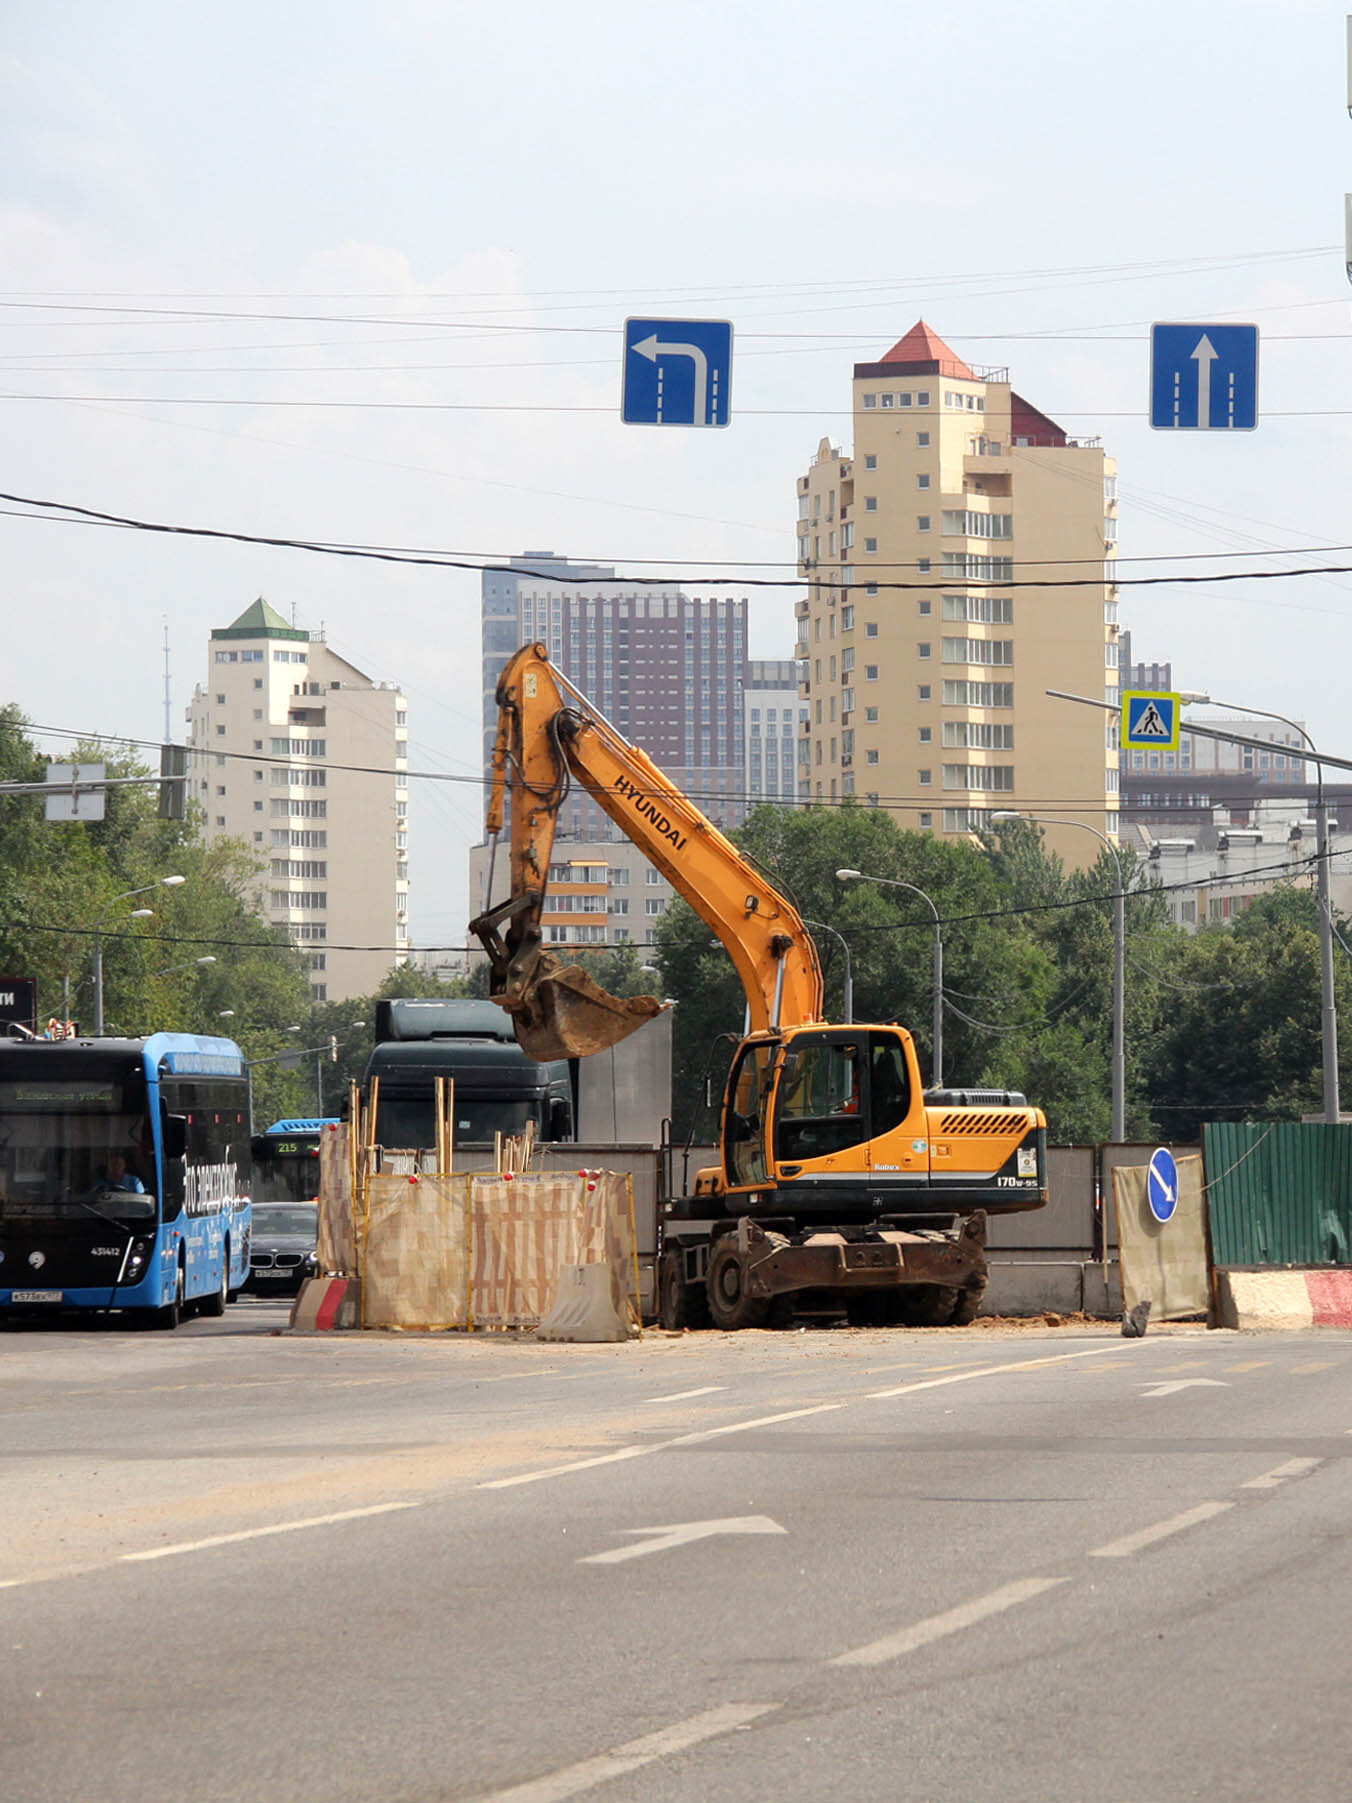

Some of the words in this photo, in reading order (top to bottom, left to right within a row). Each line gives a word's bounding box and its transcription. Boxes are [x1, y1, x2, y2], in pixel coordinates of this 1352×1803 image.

[614, 775, 687, 850] HYUNDAI
[278, 1143, 298, 1153] 215
[90, 1247, 121, 1257] 431412
